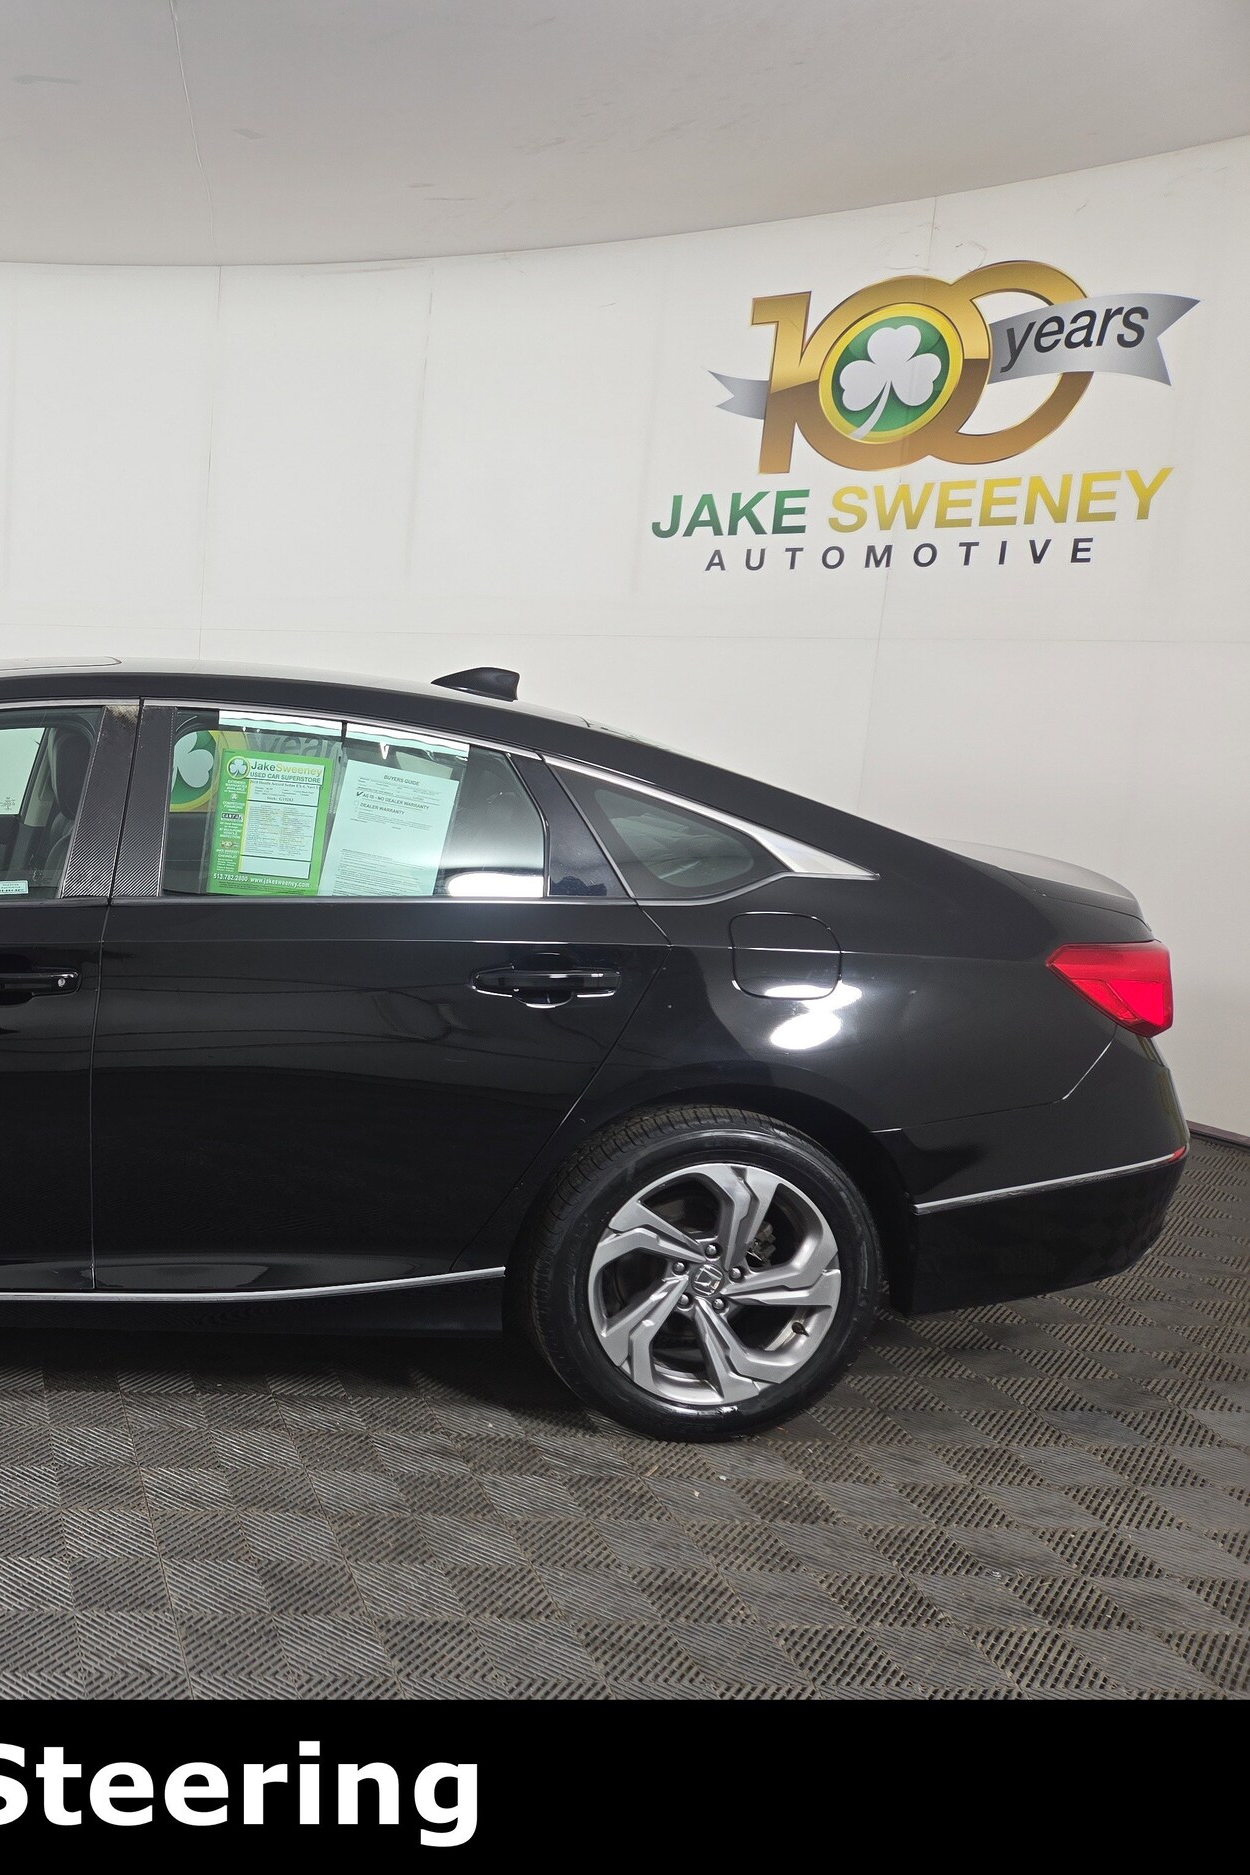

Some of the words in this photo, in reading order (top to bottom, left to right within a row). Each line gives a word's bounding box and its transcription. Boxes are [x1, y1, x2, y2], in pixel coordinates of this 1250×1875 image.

[1000, 306, 1149, 373] years
[651, 489, 810, 538] JAKE
[828, 466, 1174, 533] SWEENEY
[706, 538, 1094, 571] AUTOMOTIVE
[281, 774, 321, 783] SUPERSTORE
[384, 774, 404, 783] BUYERS
[404, 778, 420, 786] GUIDE
[360, 802, 379, 811] DEALER
[379, 806, 405, 815] WARRANTY
[403, 801, 430, 810] WARRANTY
